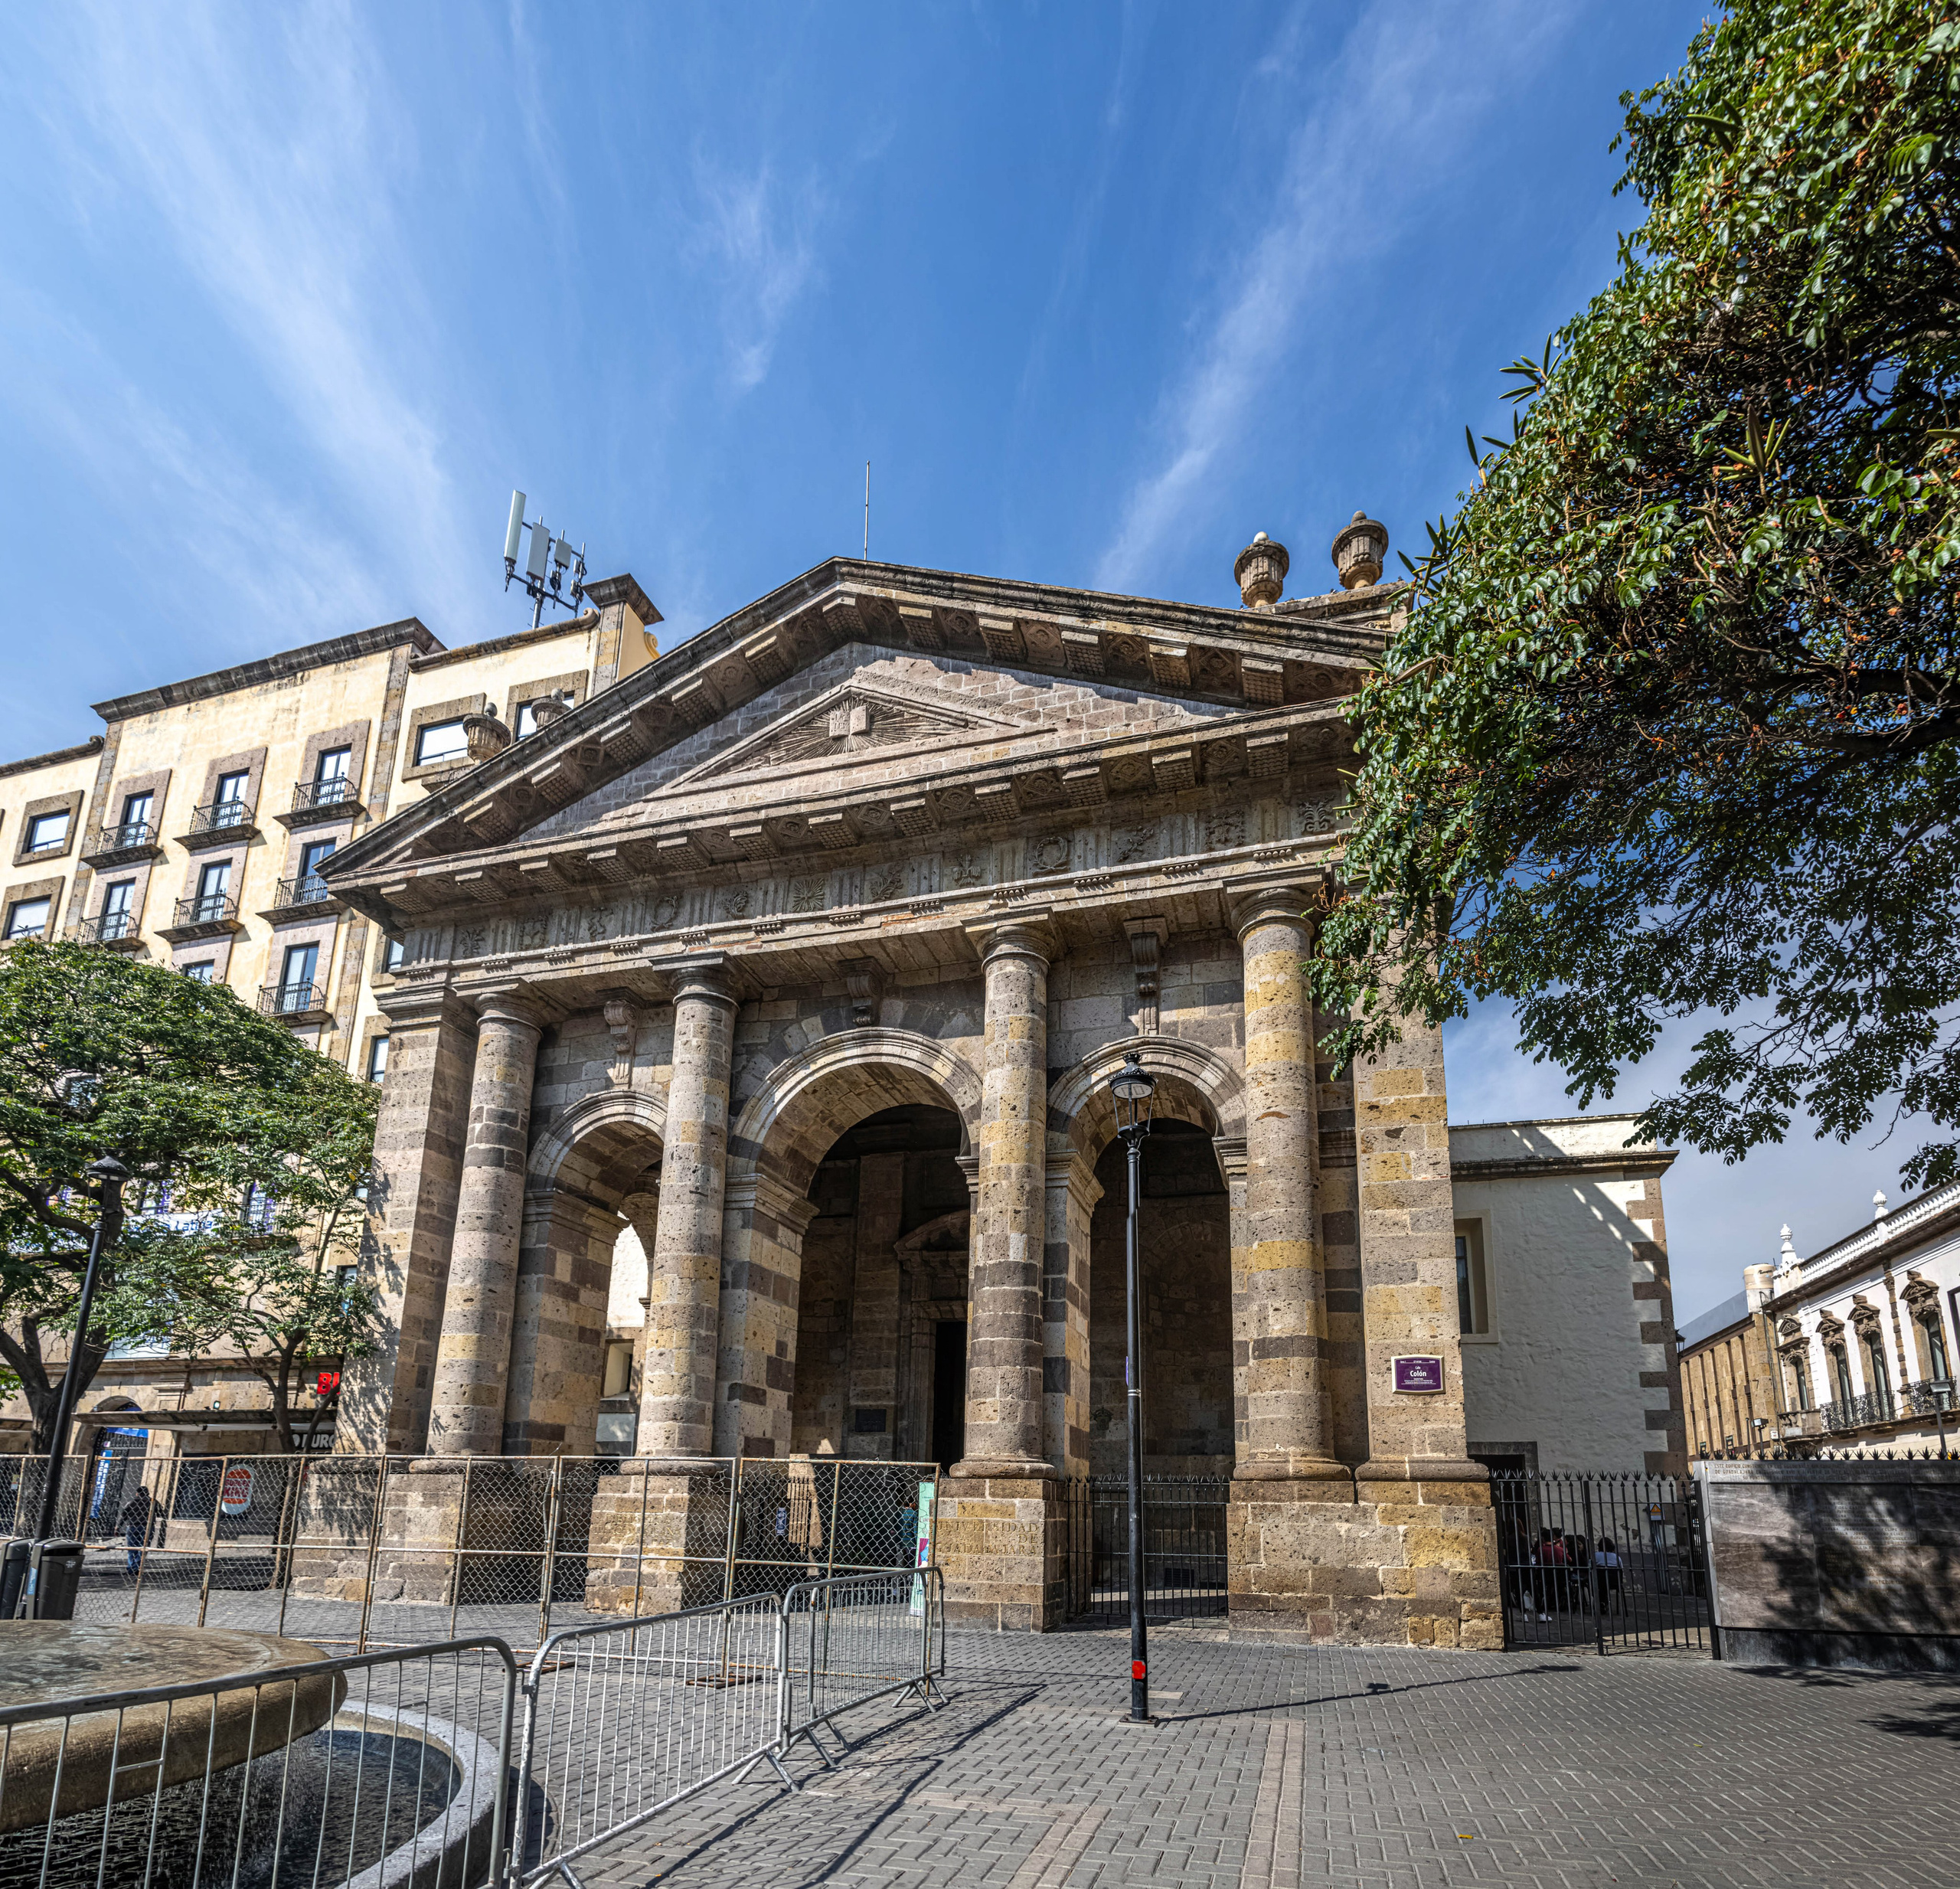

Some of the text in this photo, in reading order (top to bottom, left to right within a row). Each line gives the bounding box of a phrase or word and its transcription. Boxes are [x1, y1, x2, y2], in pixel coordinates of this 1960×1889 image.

[224, 1487, 249, 1497] KING
[936, 1521, 1038, 1533] UNIVERSIDAD
[1019, 1534, 1038, 1544] DE
[935, 1543, 1037, 1556] GUADALAJARA
